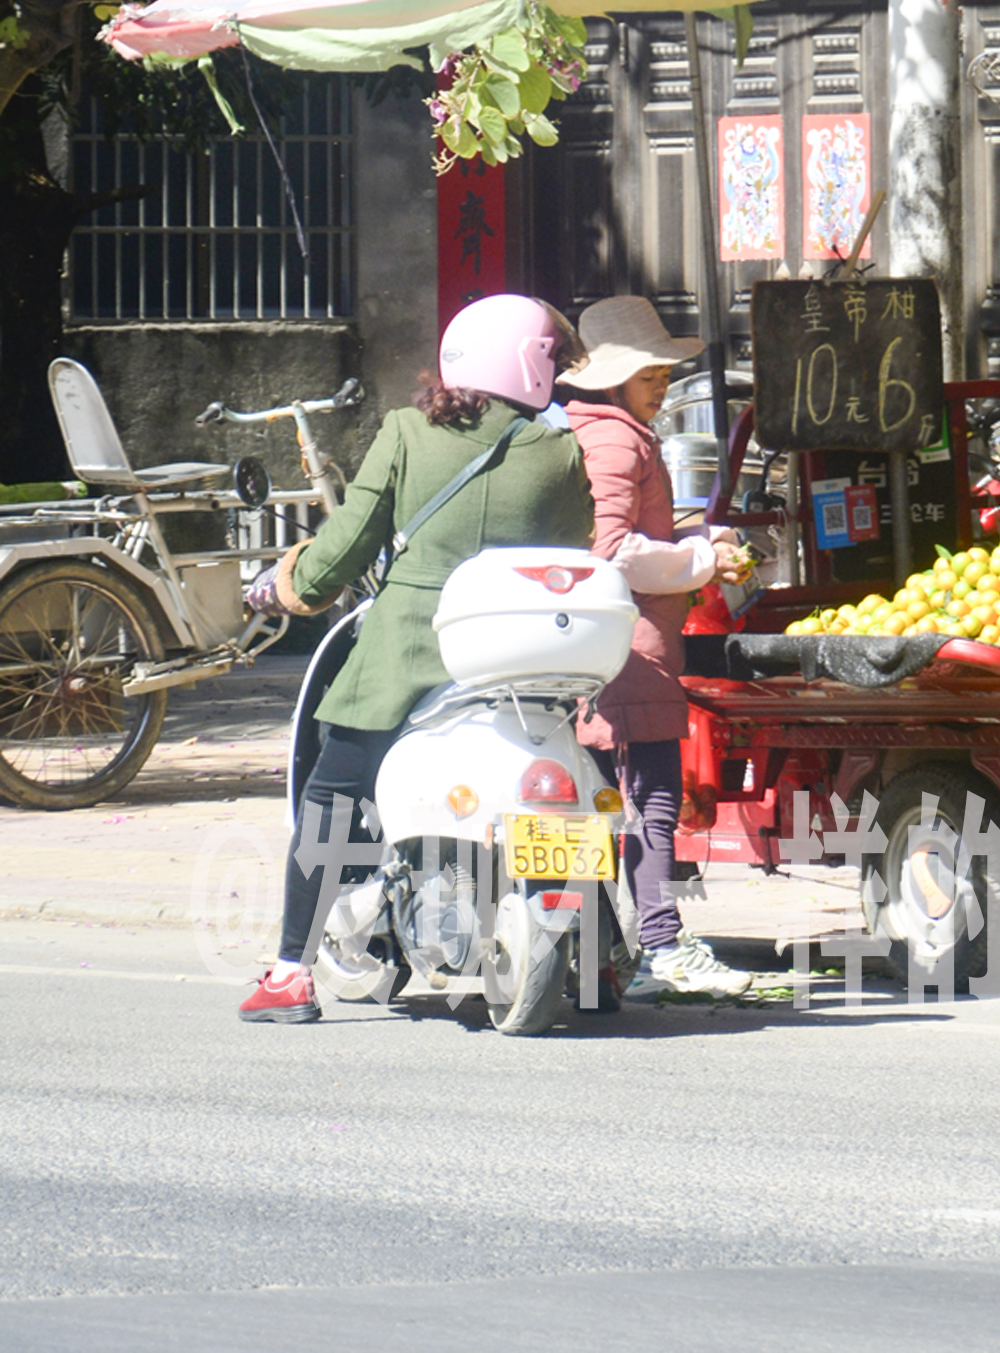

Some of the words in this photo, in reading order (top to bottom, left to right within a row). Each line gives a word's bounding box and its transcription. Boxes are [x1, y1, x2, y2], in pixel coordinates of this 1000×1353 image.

[801, 284, 916, 343] 皇帝柑
[513, 845, 608, 876] 5B032
